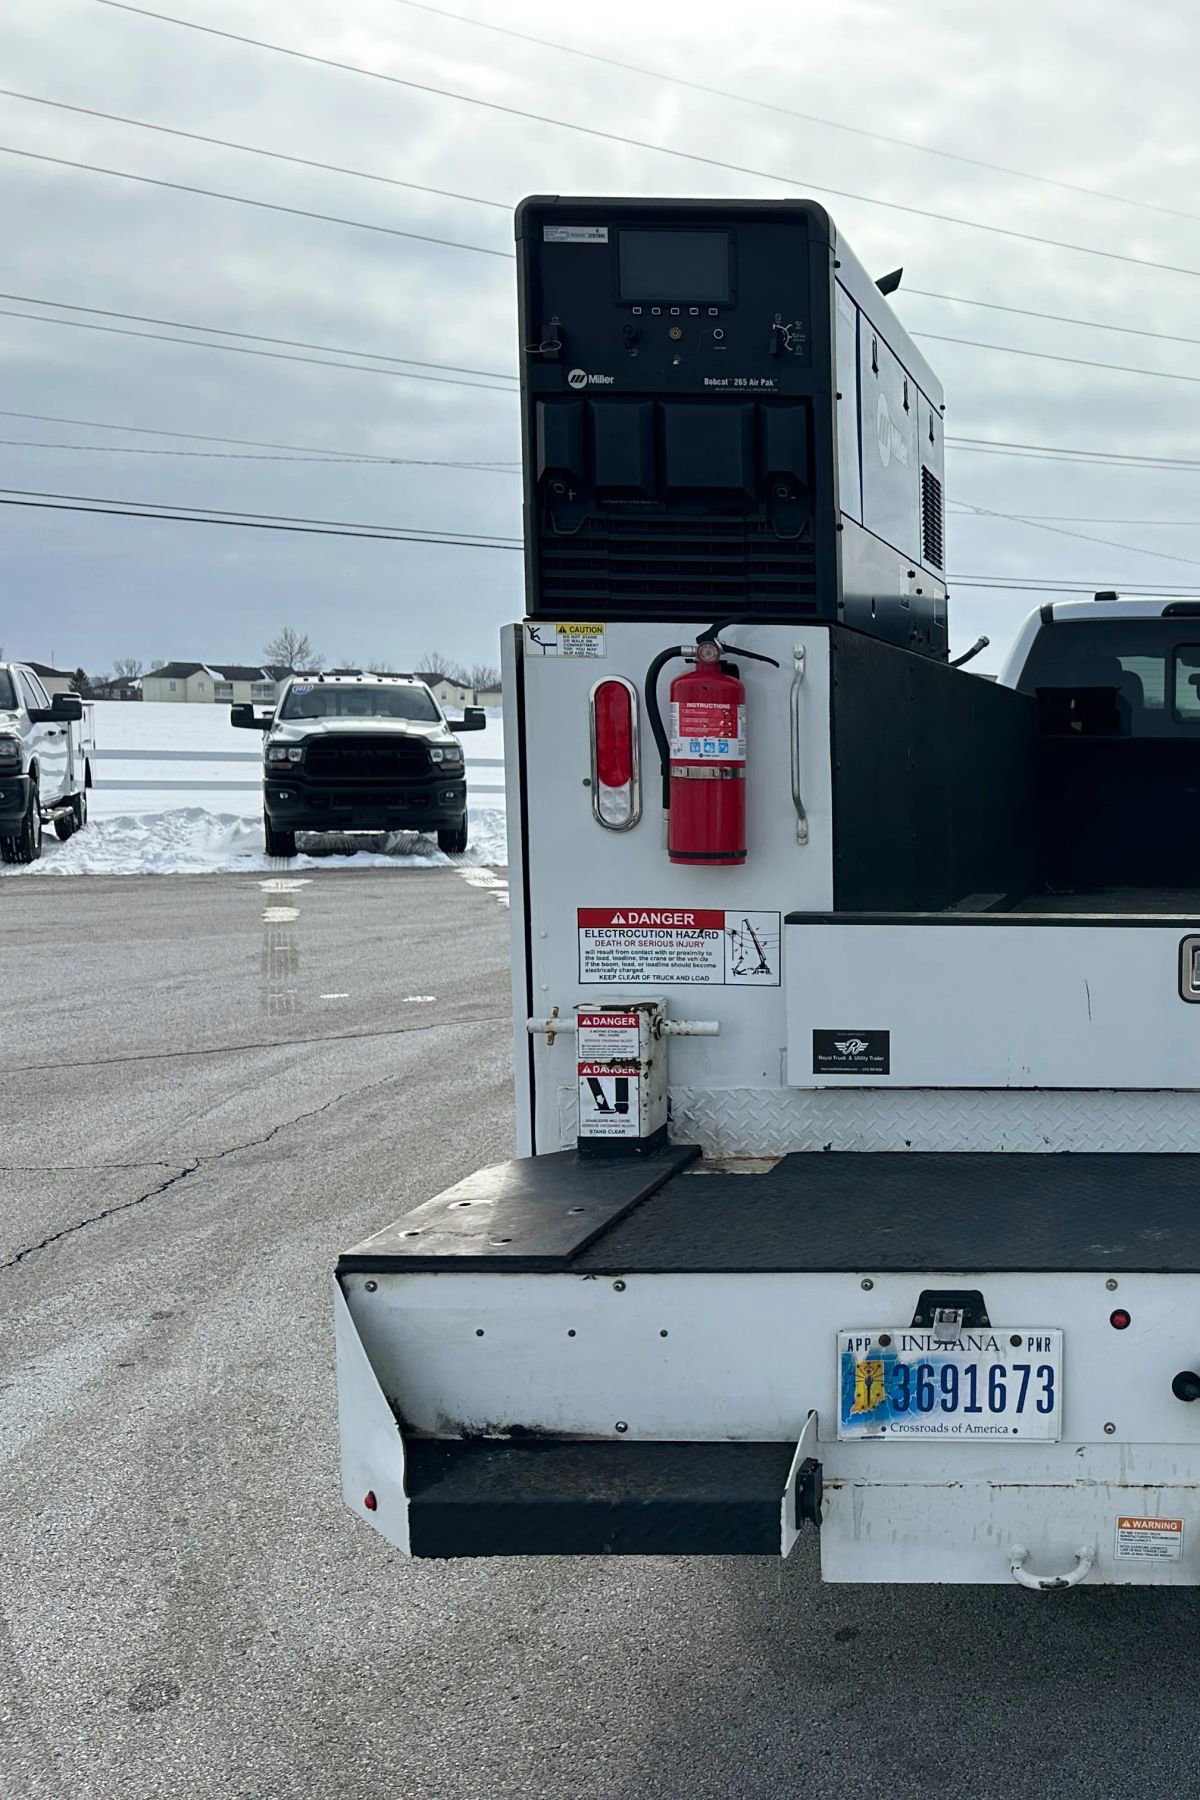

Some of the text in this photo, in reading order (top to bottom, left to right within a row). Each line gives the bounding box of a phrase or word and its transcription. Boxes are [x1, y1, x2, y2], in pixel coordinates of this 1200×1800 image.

[588, 375, 614, 384] Miller
[628, 912, 695, 925] DANGER
[585, 929, 719, 940] ELECTROCUTION HAZARD
[595, 939, 622, 947] DEATH
[638, 940, 674, 948] SERIOUS
[593, 1017, 636, 1026] DANGER
[848, 1339, 871, 1351] APP
[1028, 1338, 1051, 1352] PWR
[893, 1364, 1055, 1413] 3691673
[891, 1423, 1008, 1434] Crossroads of America
[1133, 1520, 1177, 1530] WARNING
